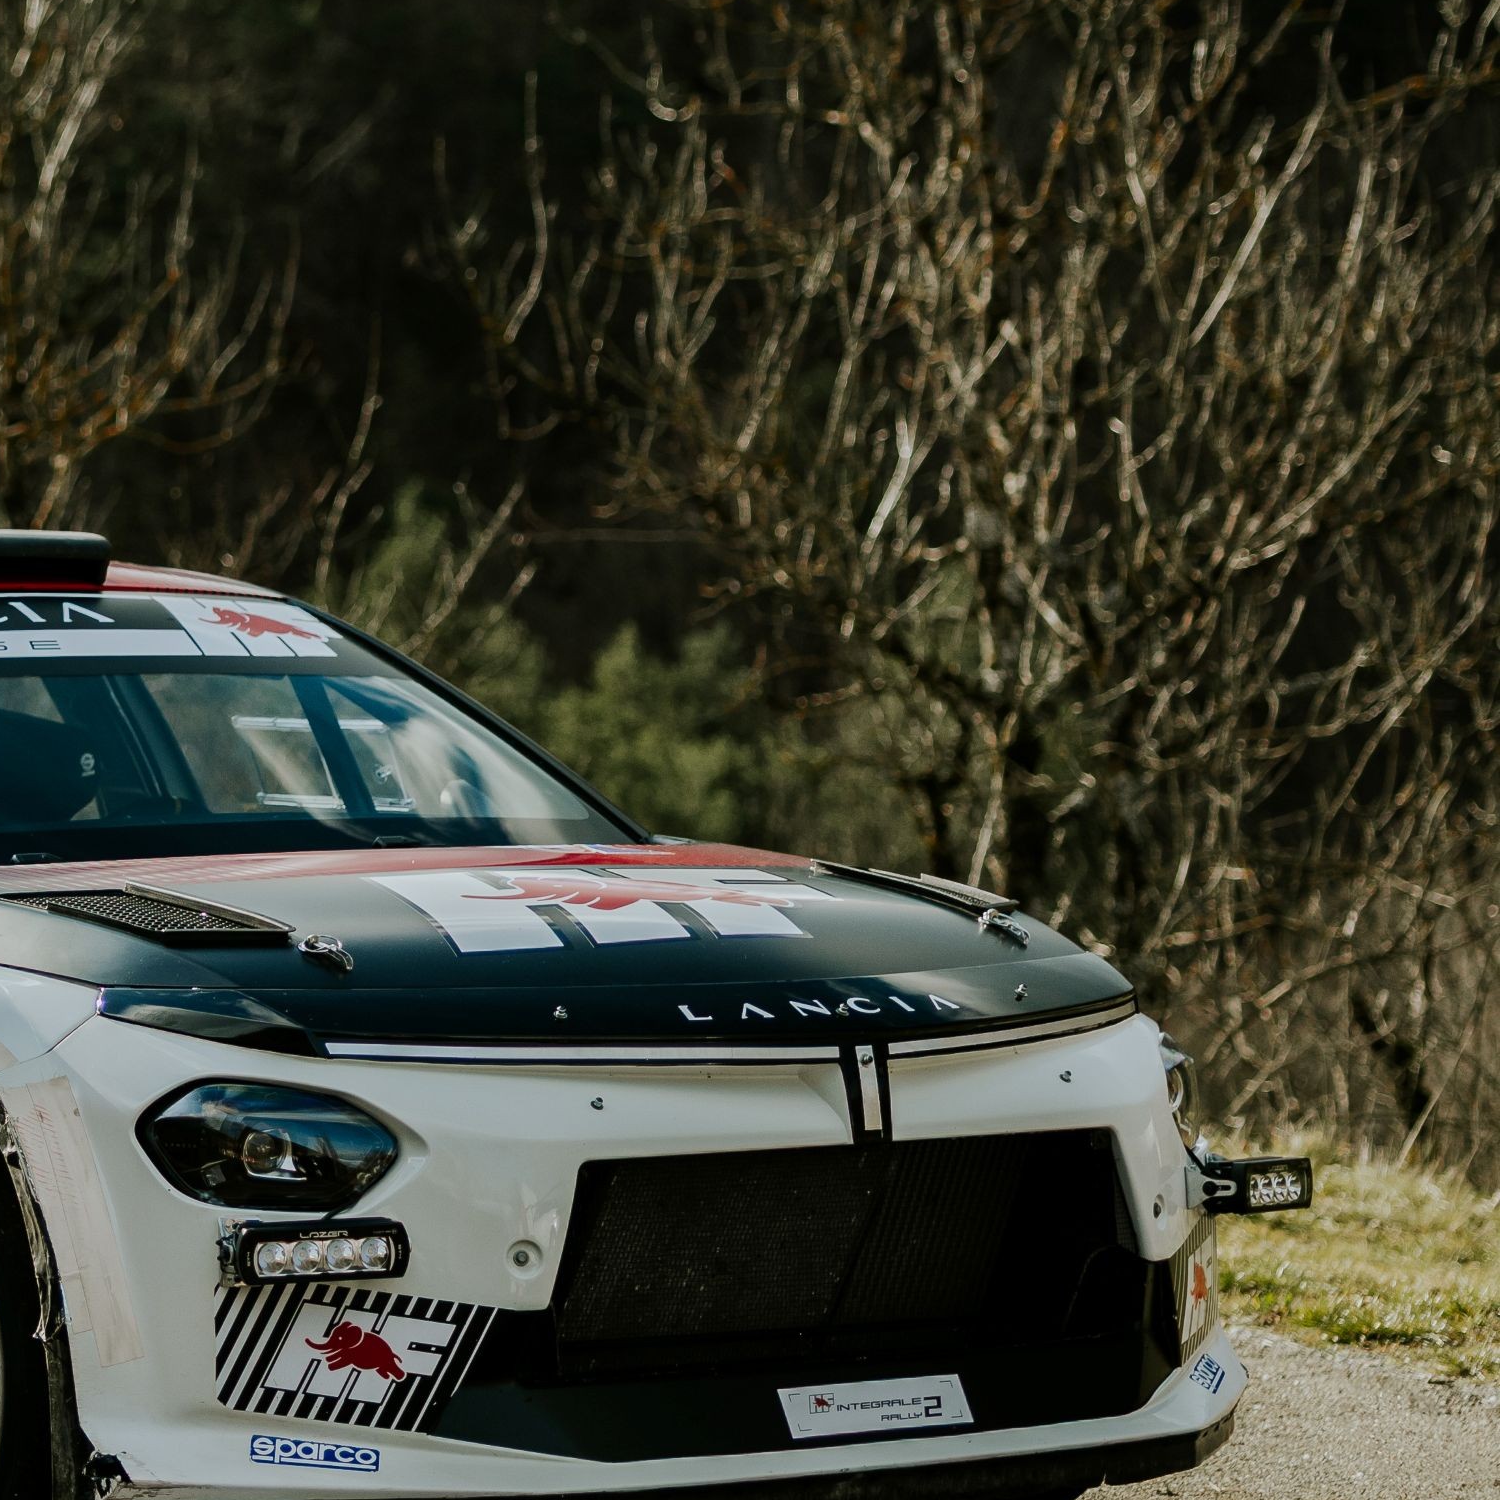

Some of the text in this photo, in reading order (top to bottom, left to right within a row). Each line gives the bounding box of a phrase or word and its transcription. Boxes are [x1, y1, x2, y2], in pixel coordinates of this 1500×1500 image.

[678, 994, 960, 1021] LANCIA
[300, 1230, 348, 1238] LAZER
[837, 1397, 922, 1412] INTEGRALE
[923, 1395, 943, 1418] 2
[881, 1412, 923, 1422] RALLY
[252, 1436, 377, 1468] sparco
